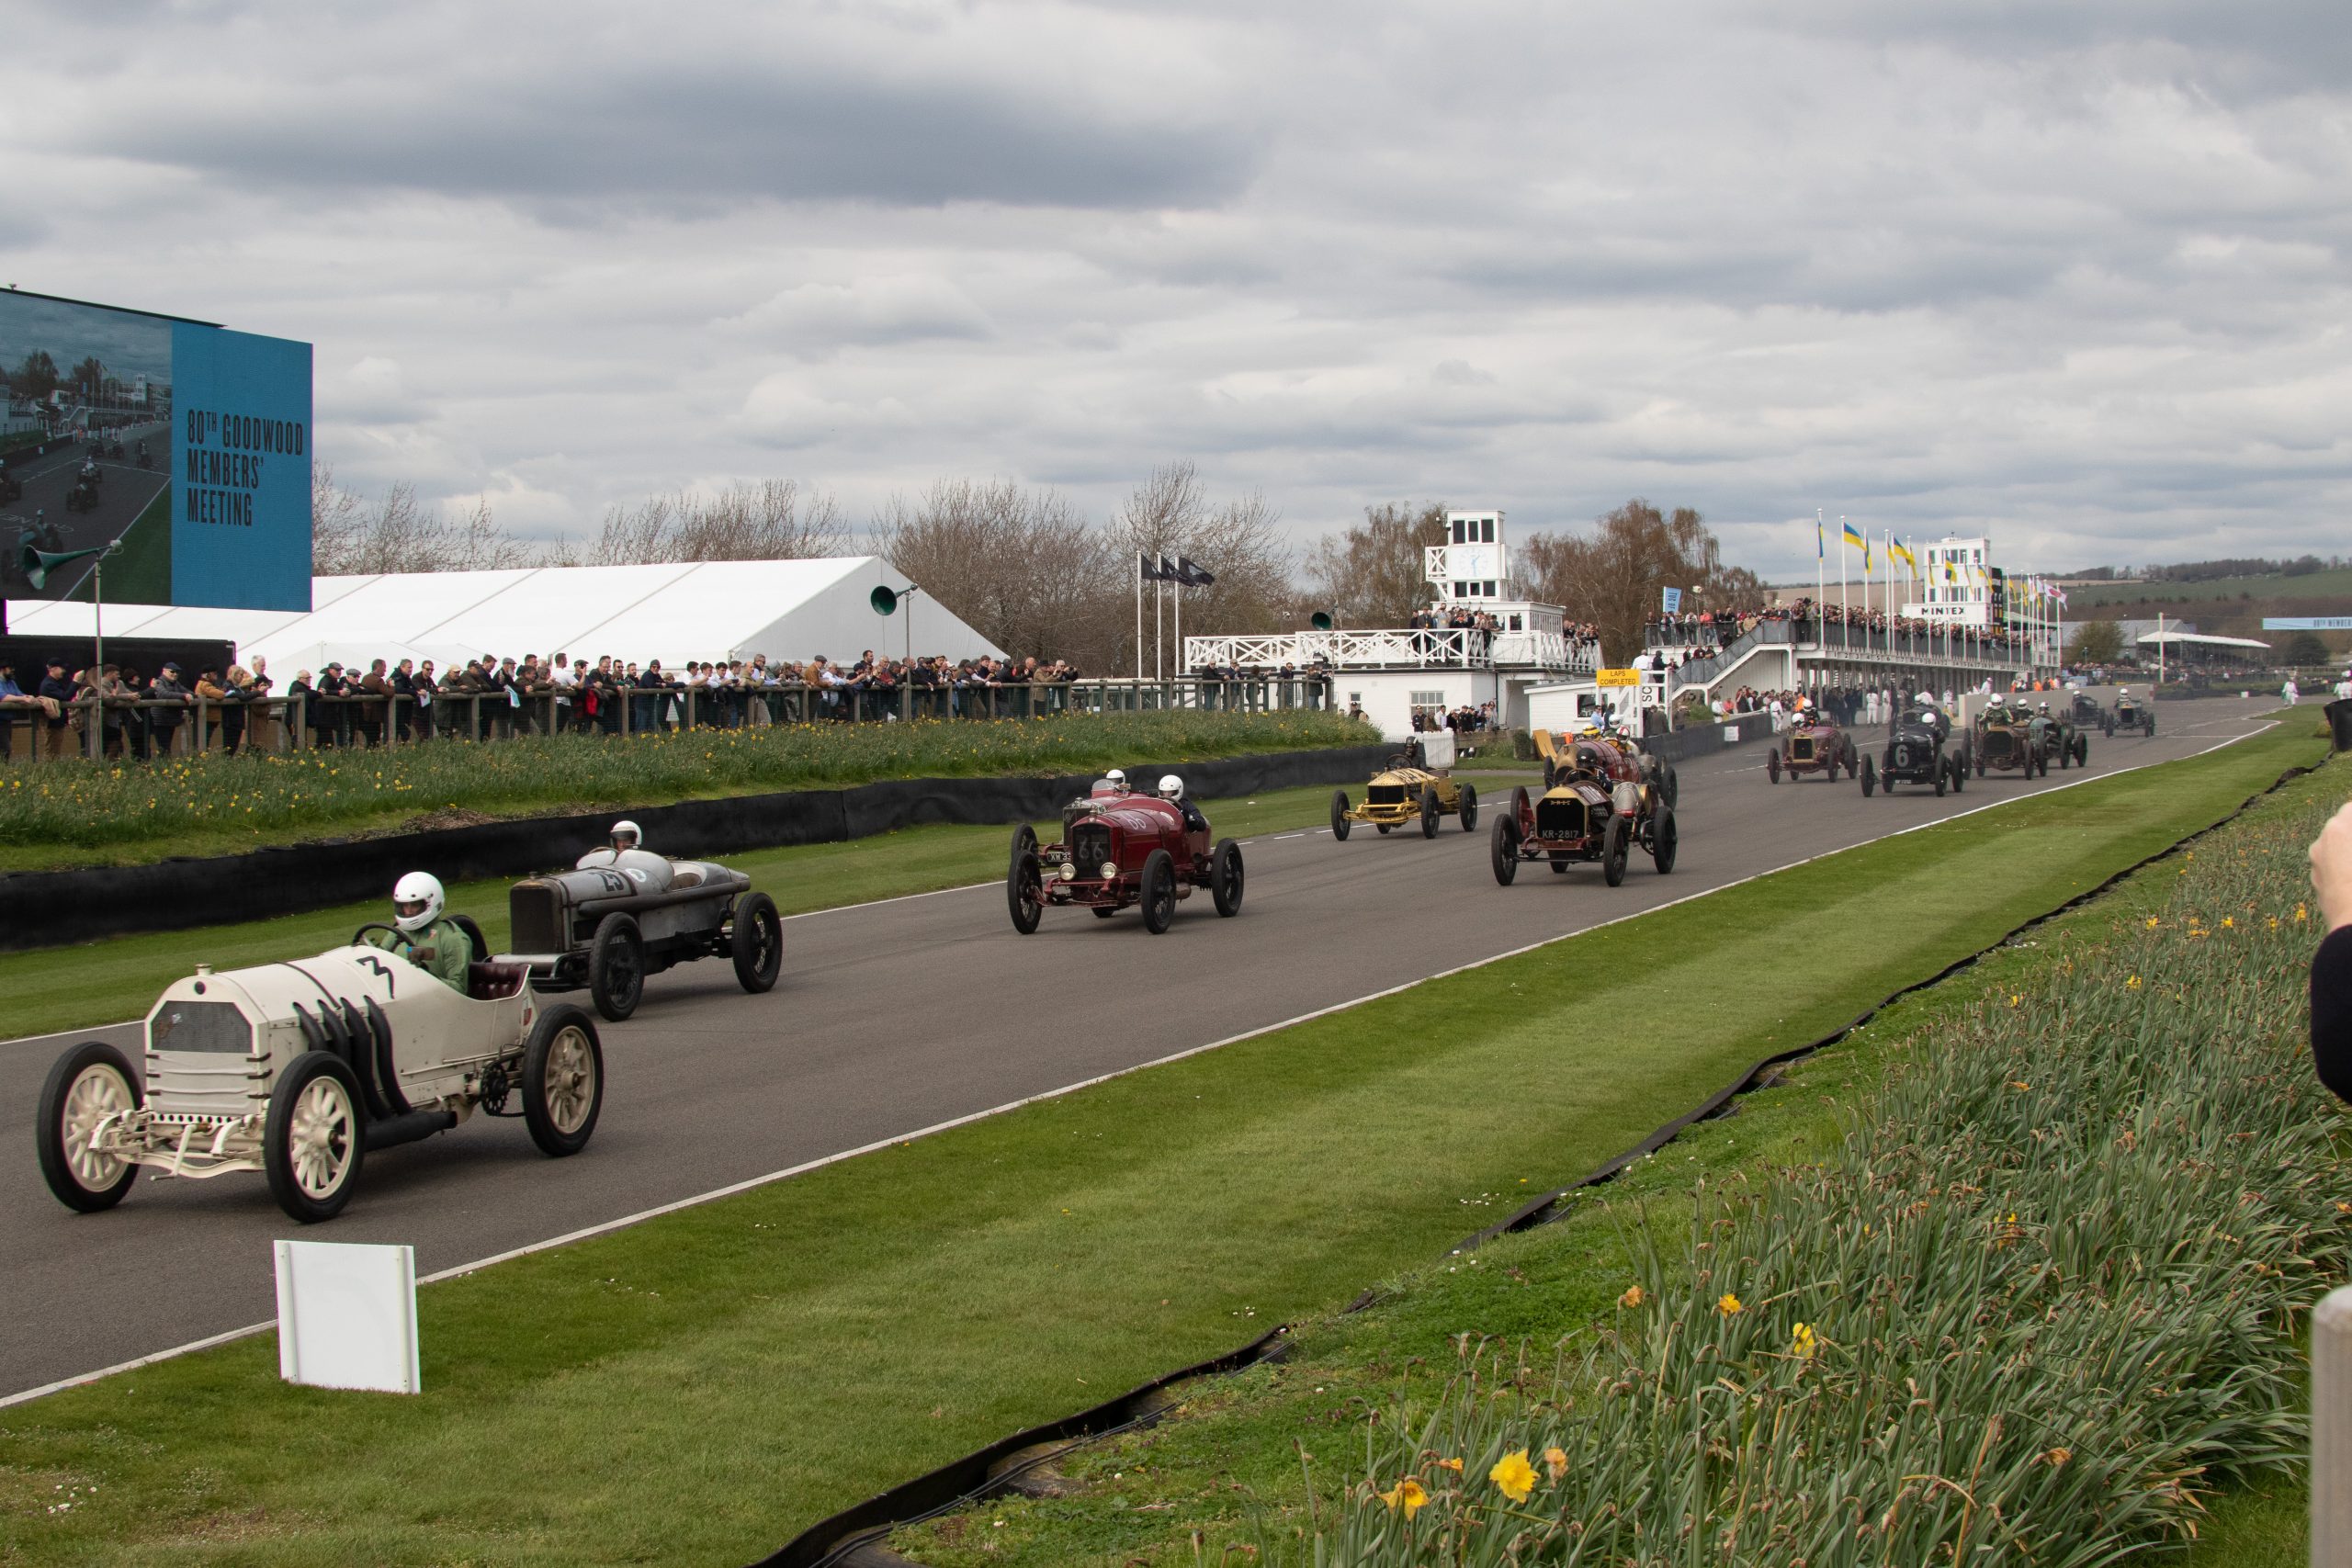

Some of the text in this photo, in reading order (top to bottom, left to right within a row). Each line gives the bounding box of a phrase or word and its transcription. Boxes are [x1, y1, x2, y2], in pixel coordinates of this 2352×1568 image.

[187, 409, 303, 456] 80TH GOODWOOD
[187, 448, 264, 489] MEMBERS'
[187, 488, 252, 526] MEETING
[1894, 744, 1909, 768] 6
[1542, 829, 1579, 839] KR-2817
[1050, 852, 1061, 861] XW
[1079, 838, 1103, 861] 66
[588, 870, 625, 892] 25
